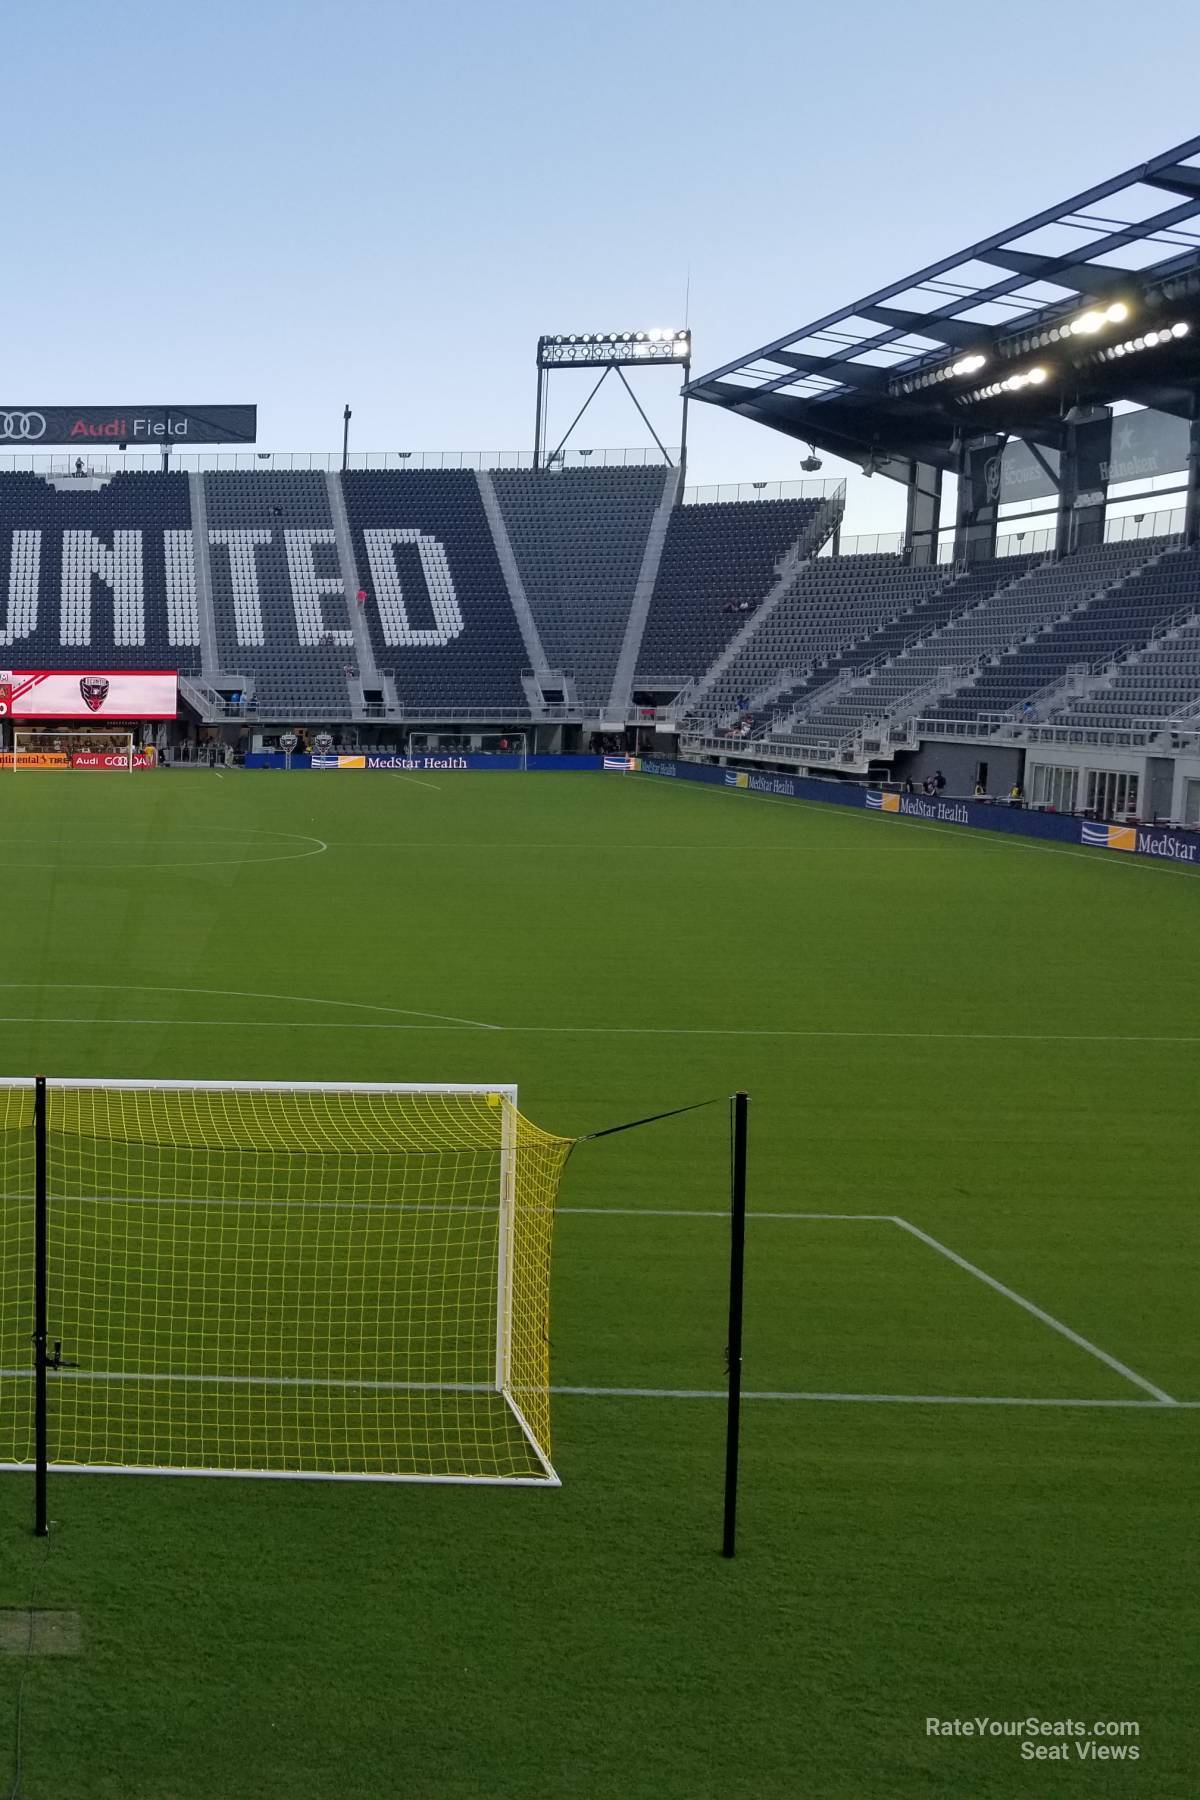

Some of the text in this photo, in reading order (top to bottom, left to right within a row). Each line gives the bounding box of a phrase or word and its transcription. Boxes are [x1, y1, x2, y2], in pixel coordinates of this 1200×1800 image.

[70, 418, 188, 437] Audi Field
[1099, 455, 1161, 480] Heineken
[76, 757, 99, 765] Audi
[367, 757, 467, 768] MedStar Health
[749, 775, 794, 796] MedStar Health
[901, 799, 969, 824] MedStar Health
[1138, 832, 1197, 861] MedStar
